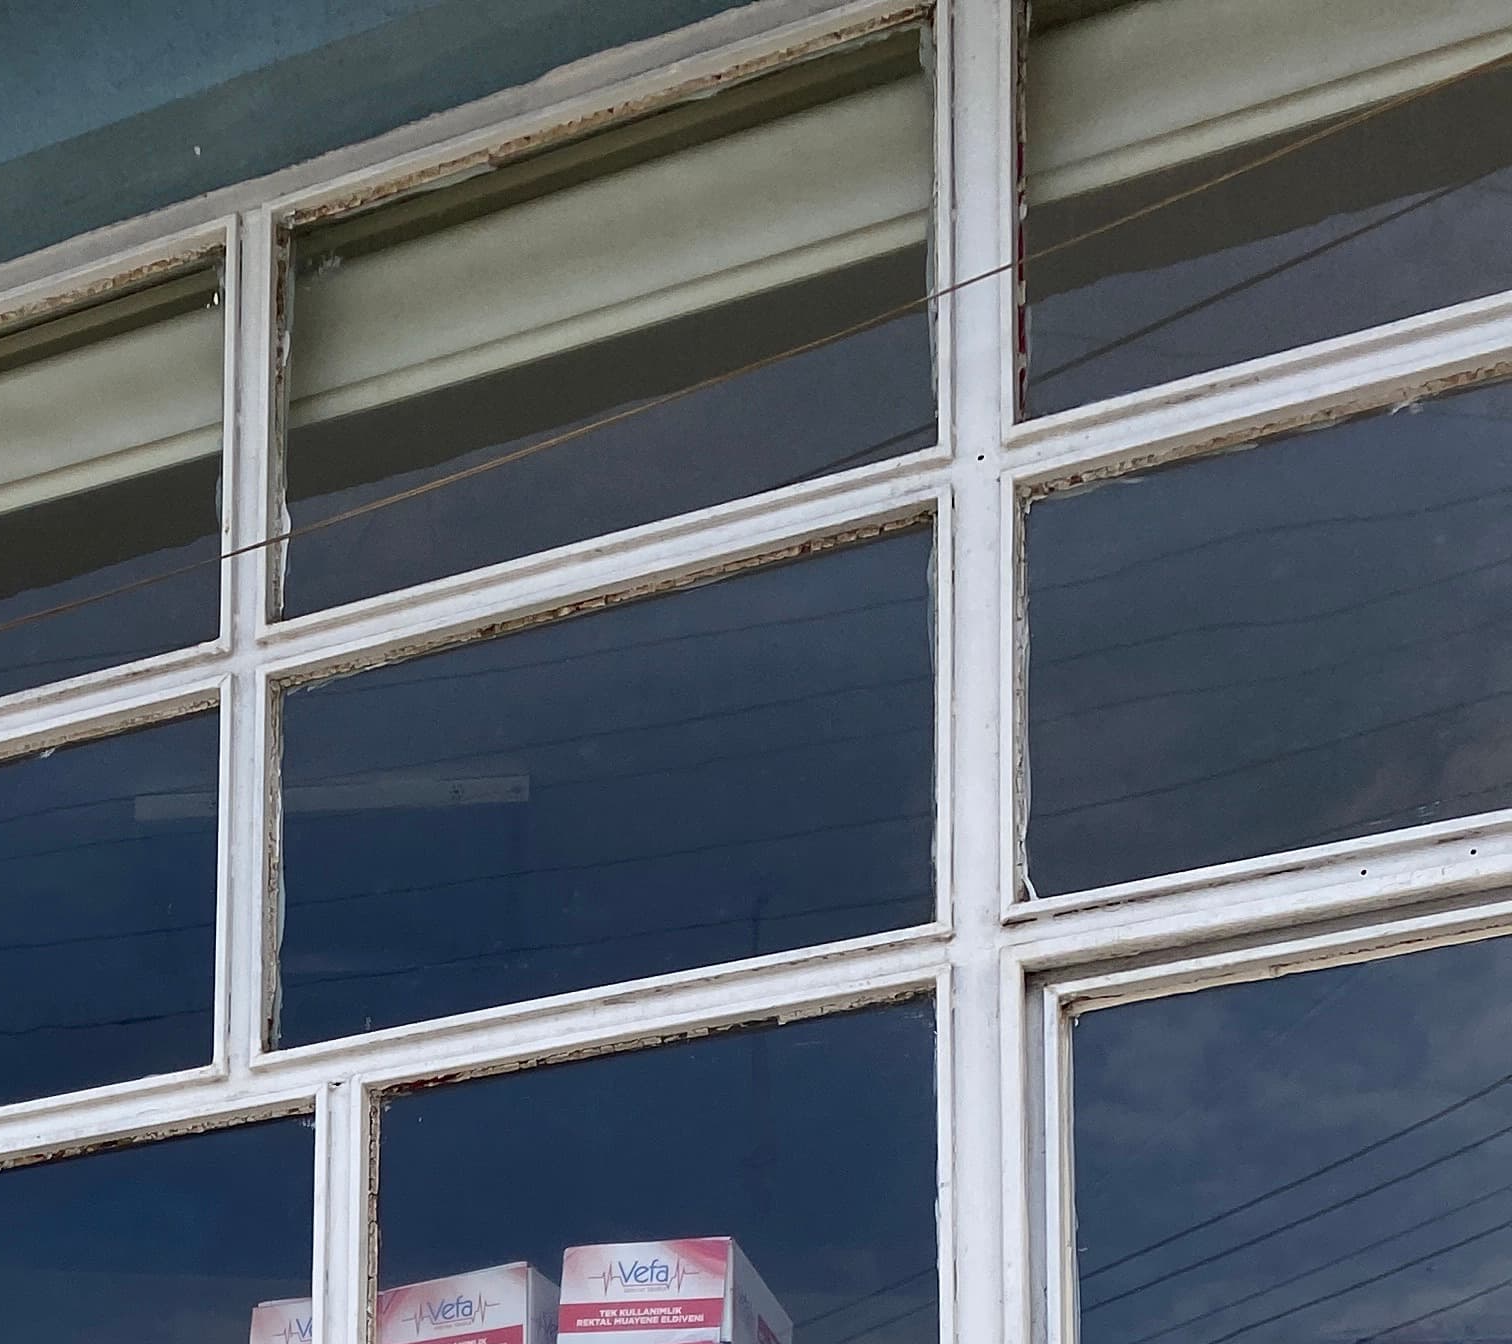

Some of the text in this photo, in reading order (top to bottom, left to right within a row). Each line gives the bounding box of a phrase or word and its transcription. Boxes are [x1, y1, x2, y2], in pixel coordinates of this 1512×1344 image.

[617, 1258, 669, 1283] Vefa
[427, 1295, 473, 1321] Vefa
[599, 1307, 682, 1317] TEK KULLANIMLIK
[576, 1318, 613, 1327] REKTAL
[614, 1316, 659, 1326] MUAYENE
